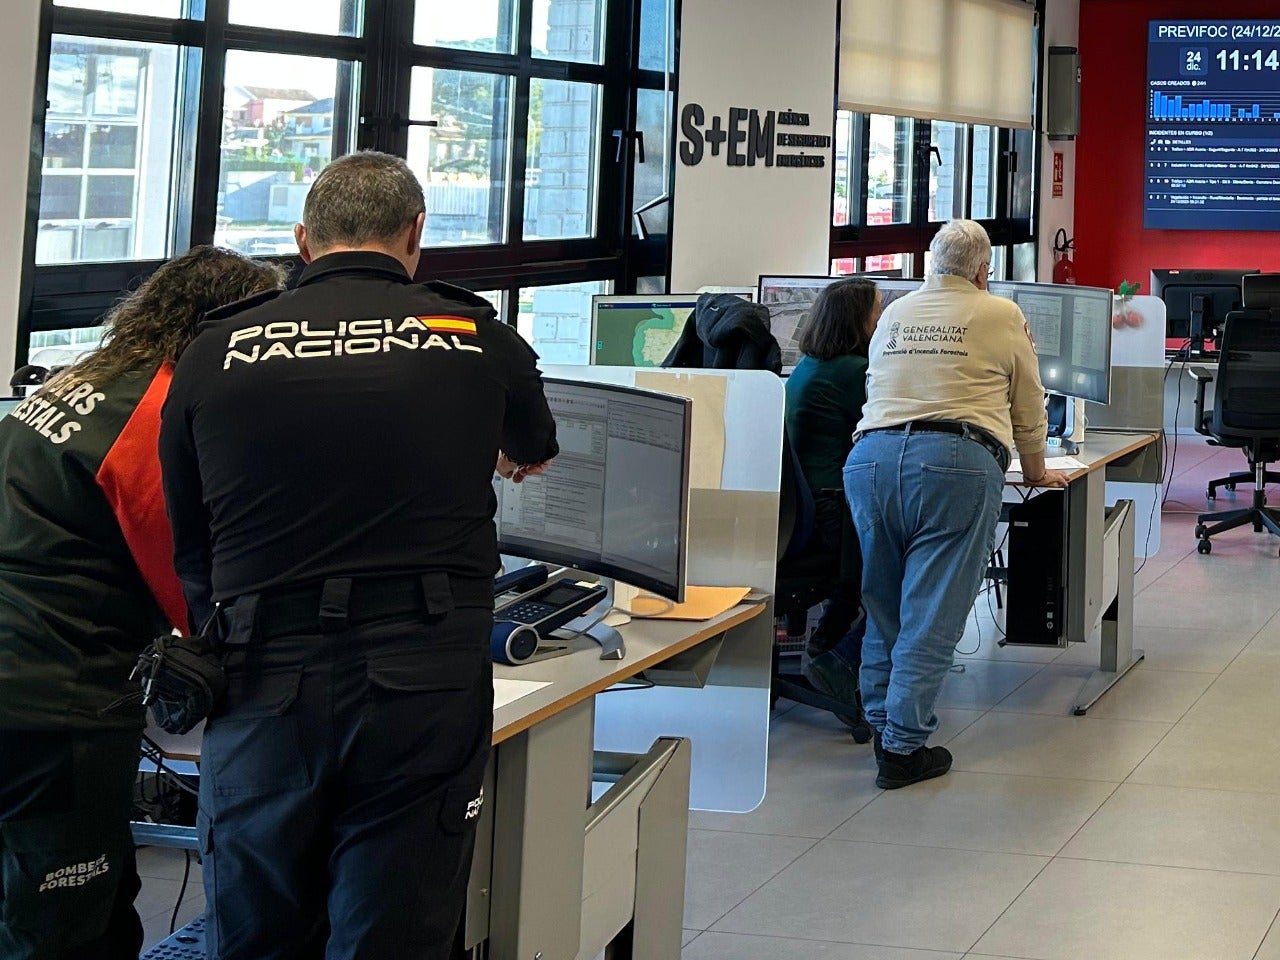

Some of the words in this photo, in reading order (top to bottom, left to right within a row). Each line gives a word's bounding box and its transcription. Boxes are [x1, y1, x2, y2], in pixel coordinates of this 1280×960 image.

[1158, 25, 1228, 38] PREVIFOC
[1186, 51, 1201, 63] 24
[1186, 61, 1201, 71] dic.
[680, 103, 776, 167] S+EM
[227, 316, 428, 349] POLICIA
[903, 325, 968, 335] GENERALITAT
[902, 334, 964, 343] VALENCIANA
[223, 333, 483, 371] NACIONAL
